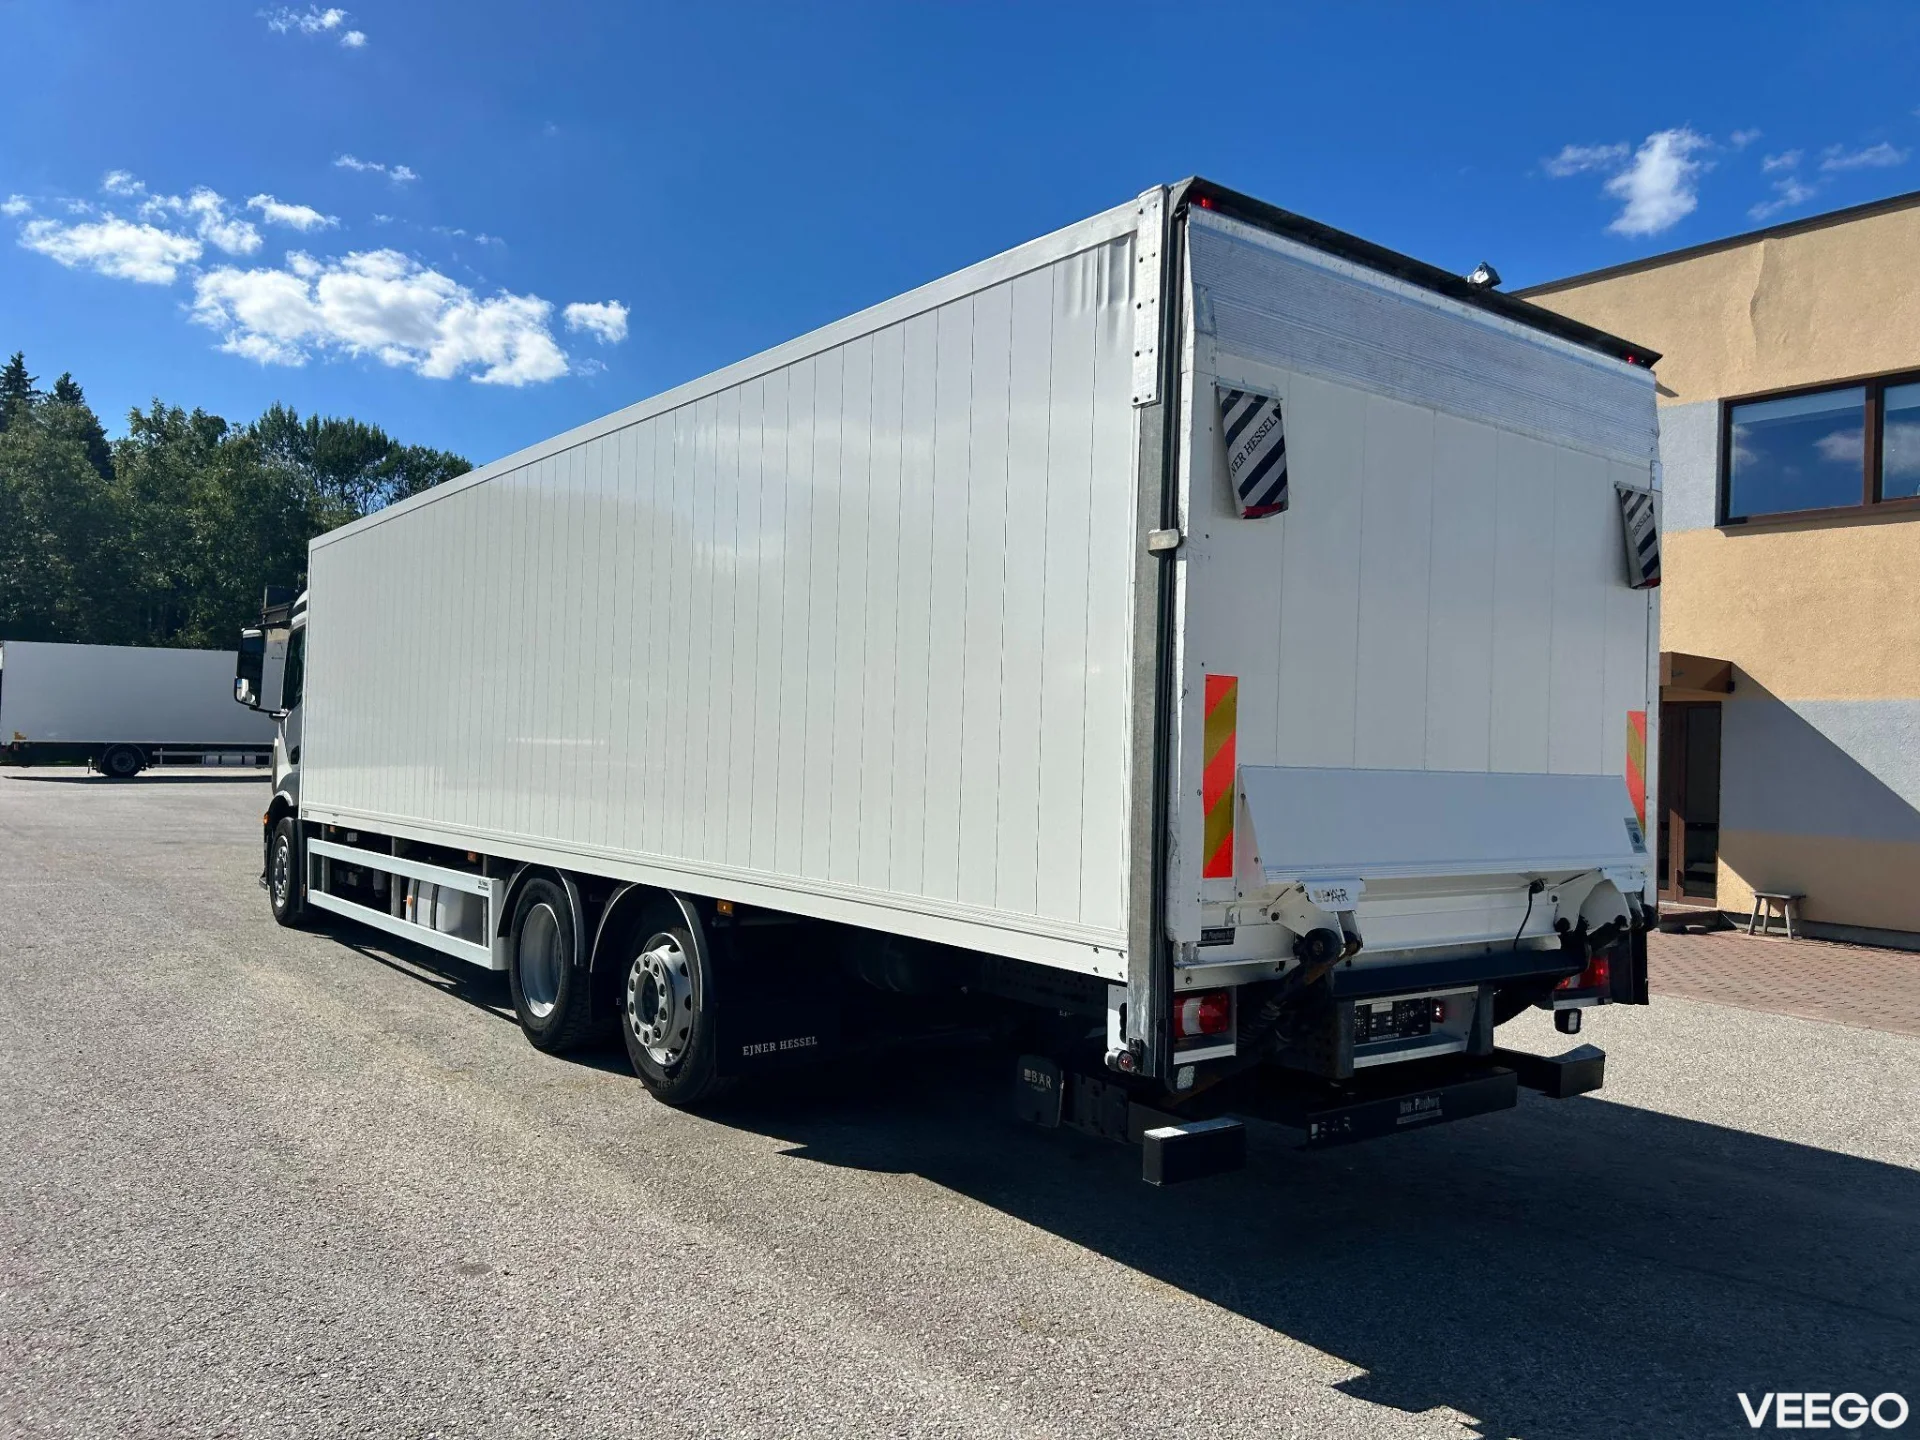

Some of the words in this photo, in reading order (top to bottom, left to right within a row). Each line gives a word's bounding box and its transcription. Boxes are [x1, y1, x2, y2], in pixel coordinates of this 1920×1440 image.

[1230, 451, 1247, 477] NER
[1243, 416, 1278, 456] HESSEL
[779, 1036, 818, 1050] HESSEL
